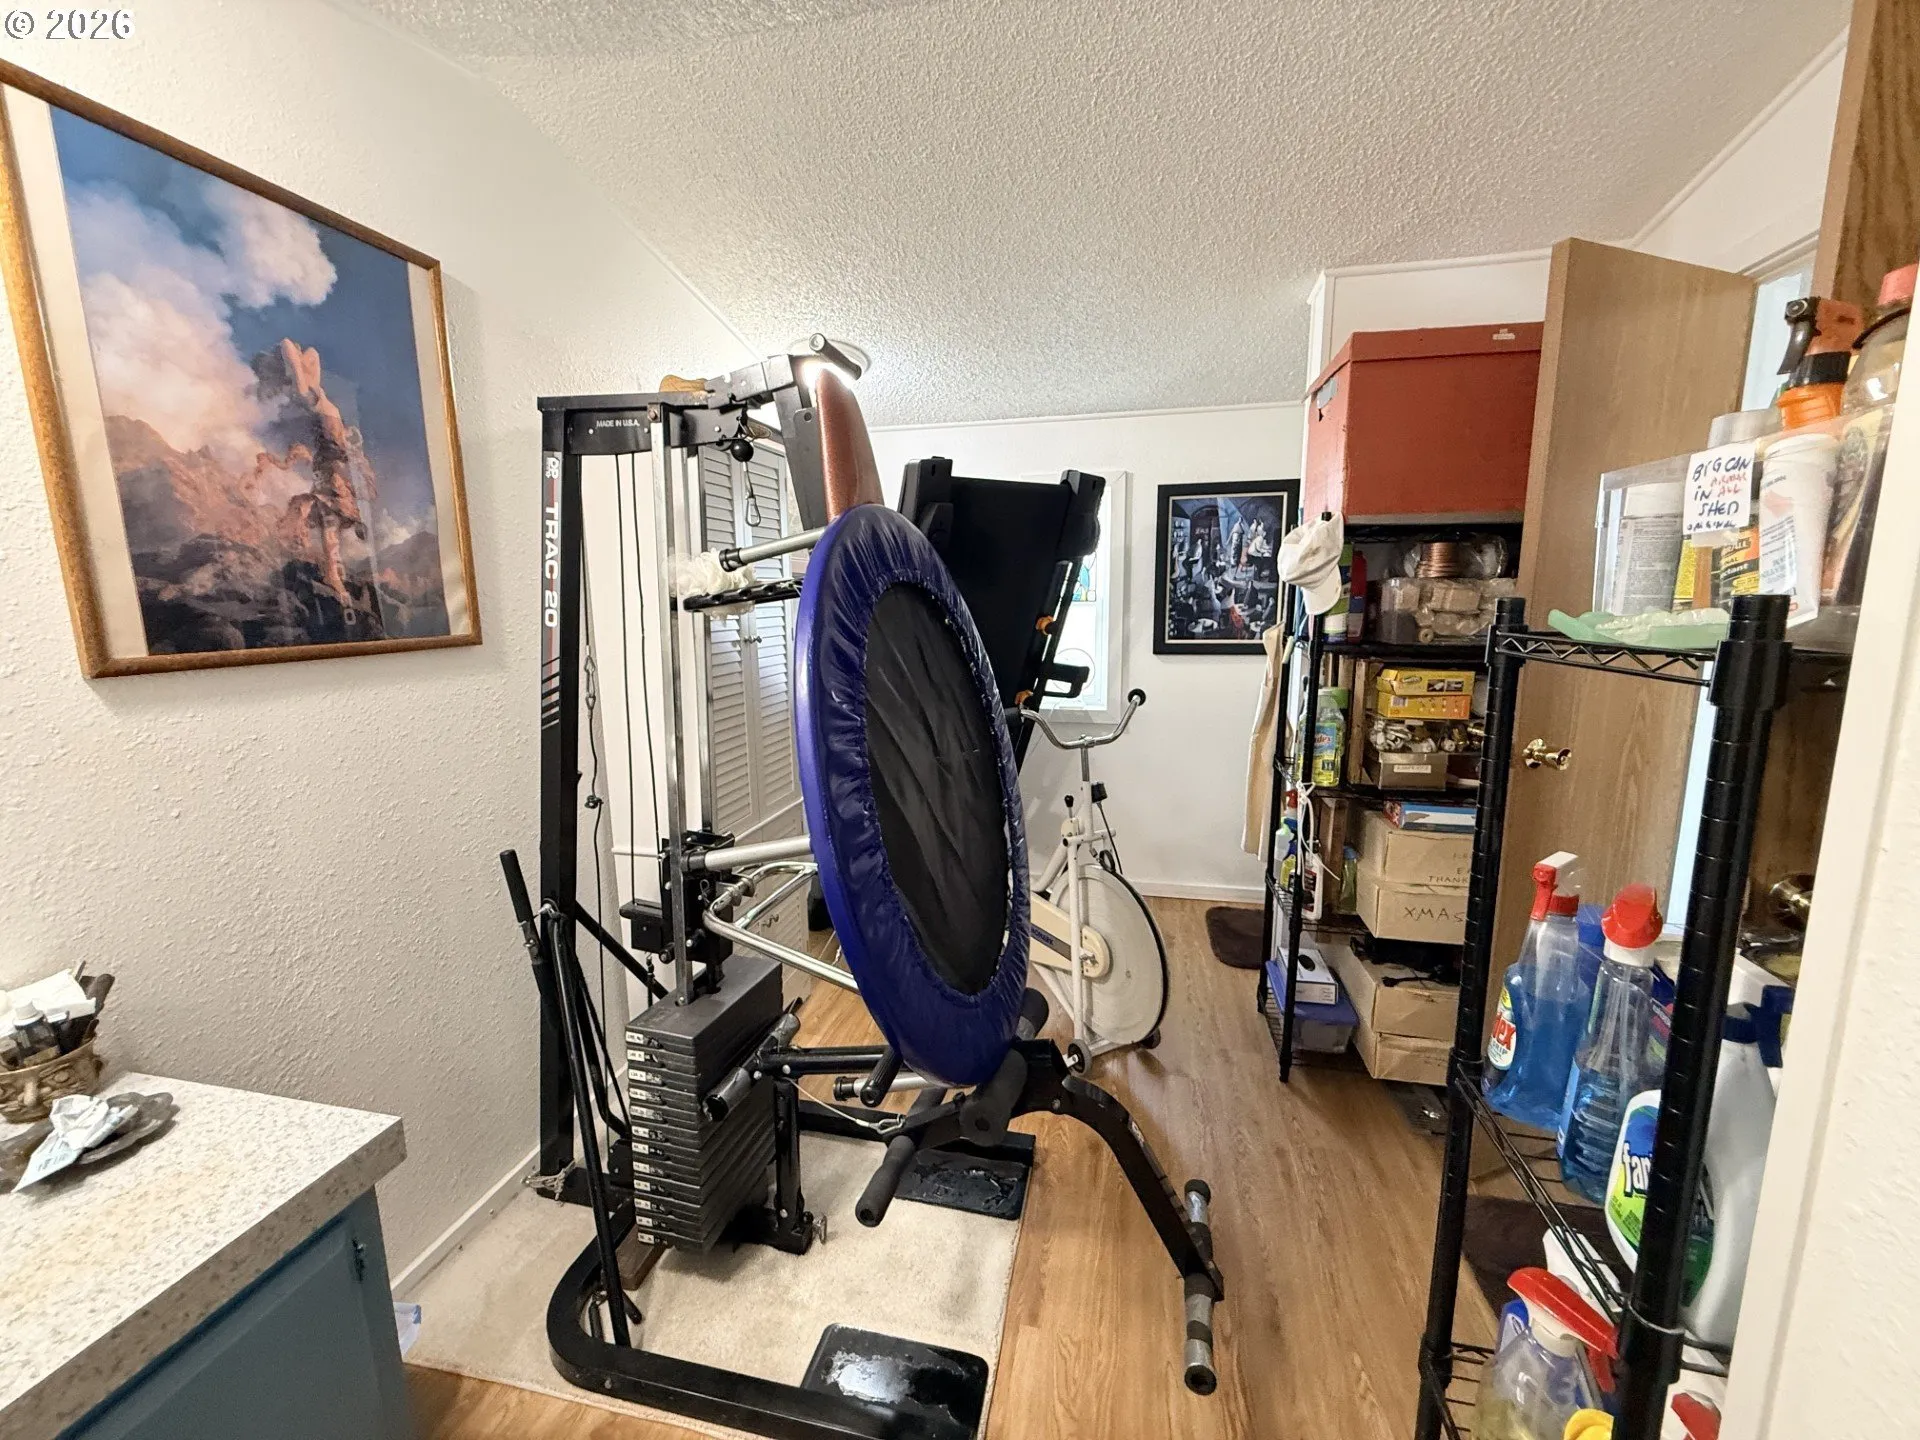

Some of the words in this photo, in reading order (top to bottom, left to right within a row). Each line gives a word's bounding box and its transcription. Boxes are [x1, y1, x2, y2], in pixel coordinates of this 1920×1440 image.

[596, 419, 614, 428] MADE
[615, 419, 622, 427] IN
[1724, 455, 1752, 473] CAN
[1698, 500, 1741, 516] SHED
[545, 501, 559, 580] TRAC
[544, 589, 559, 628] 20
[1403, 906, 1465, 922] XMAS
